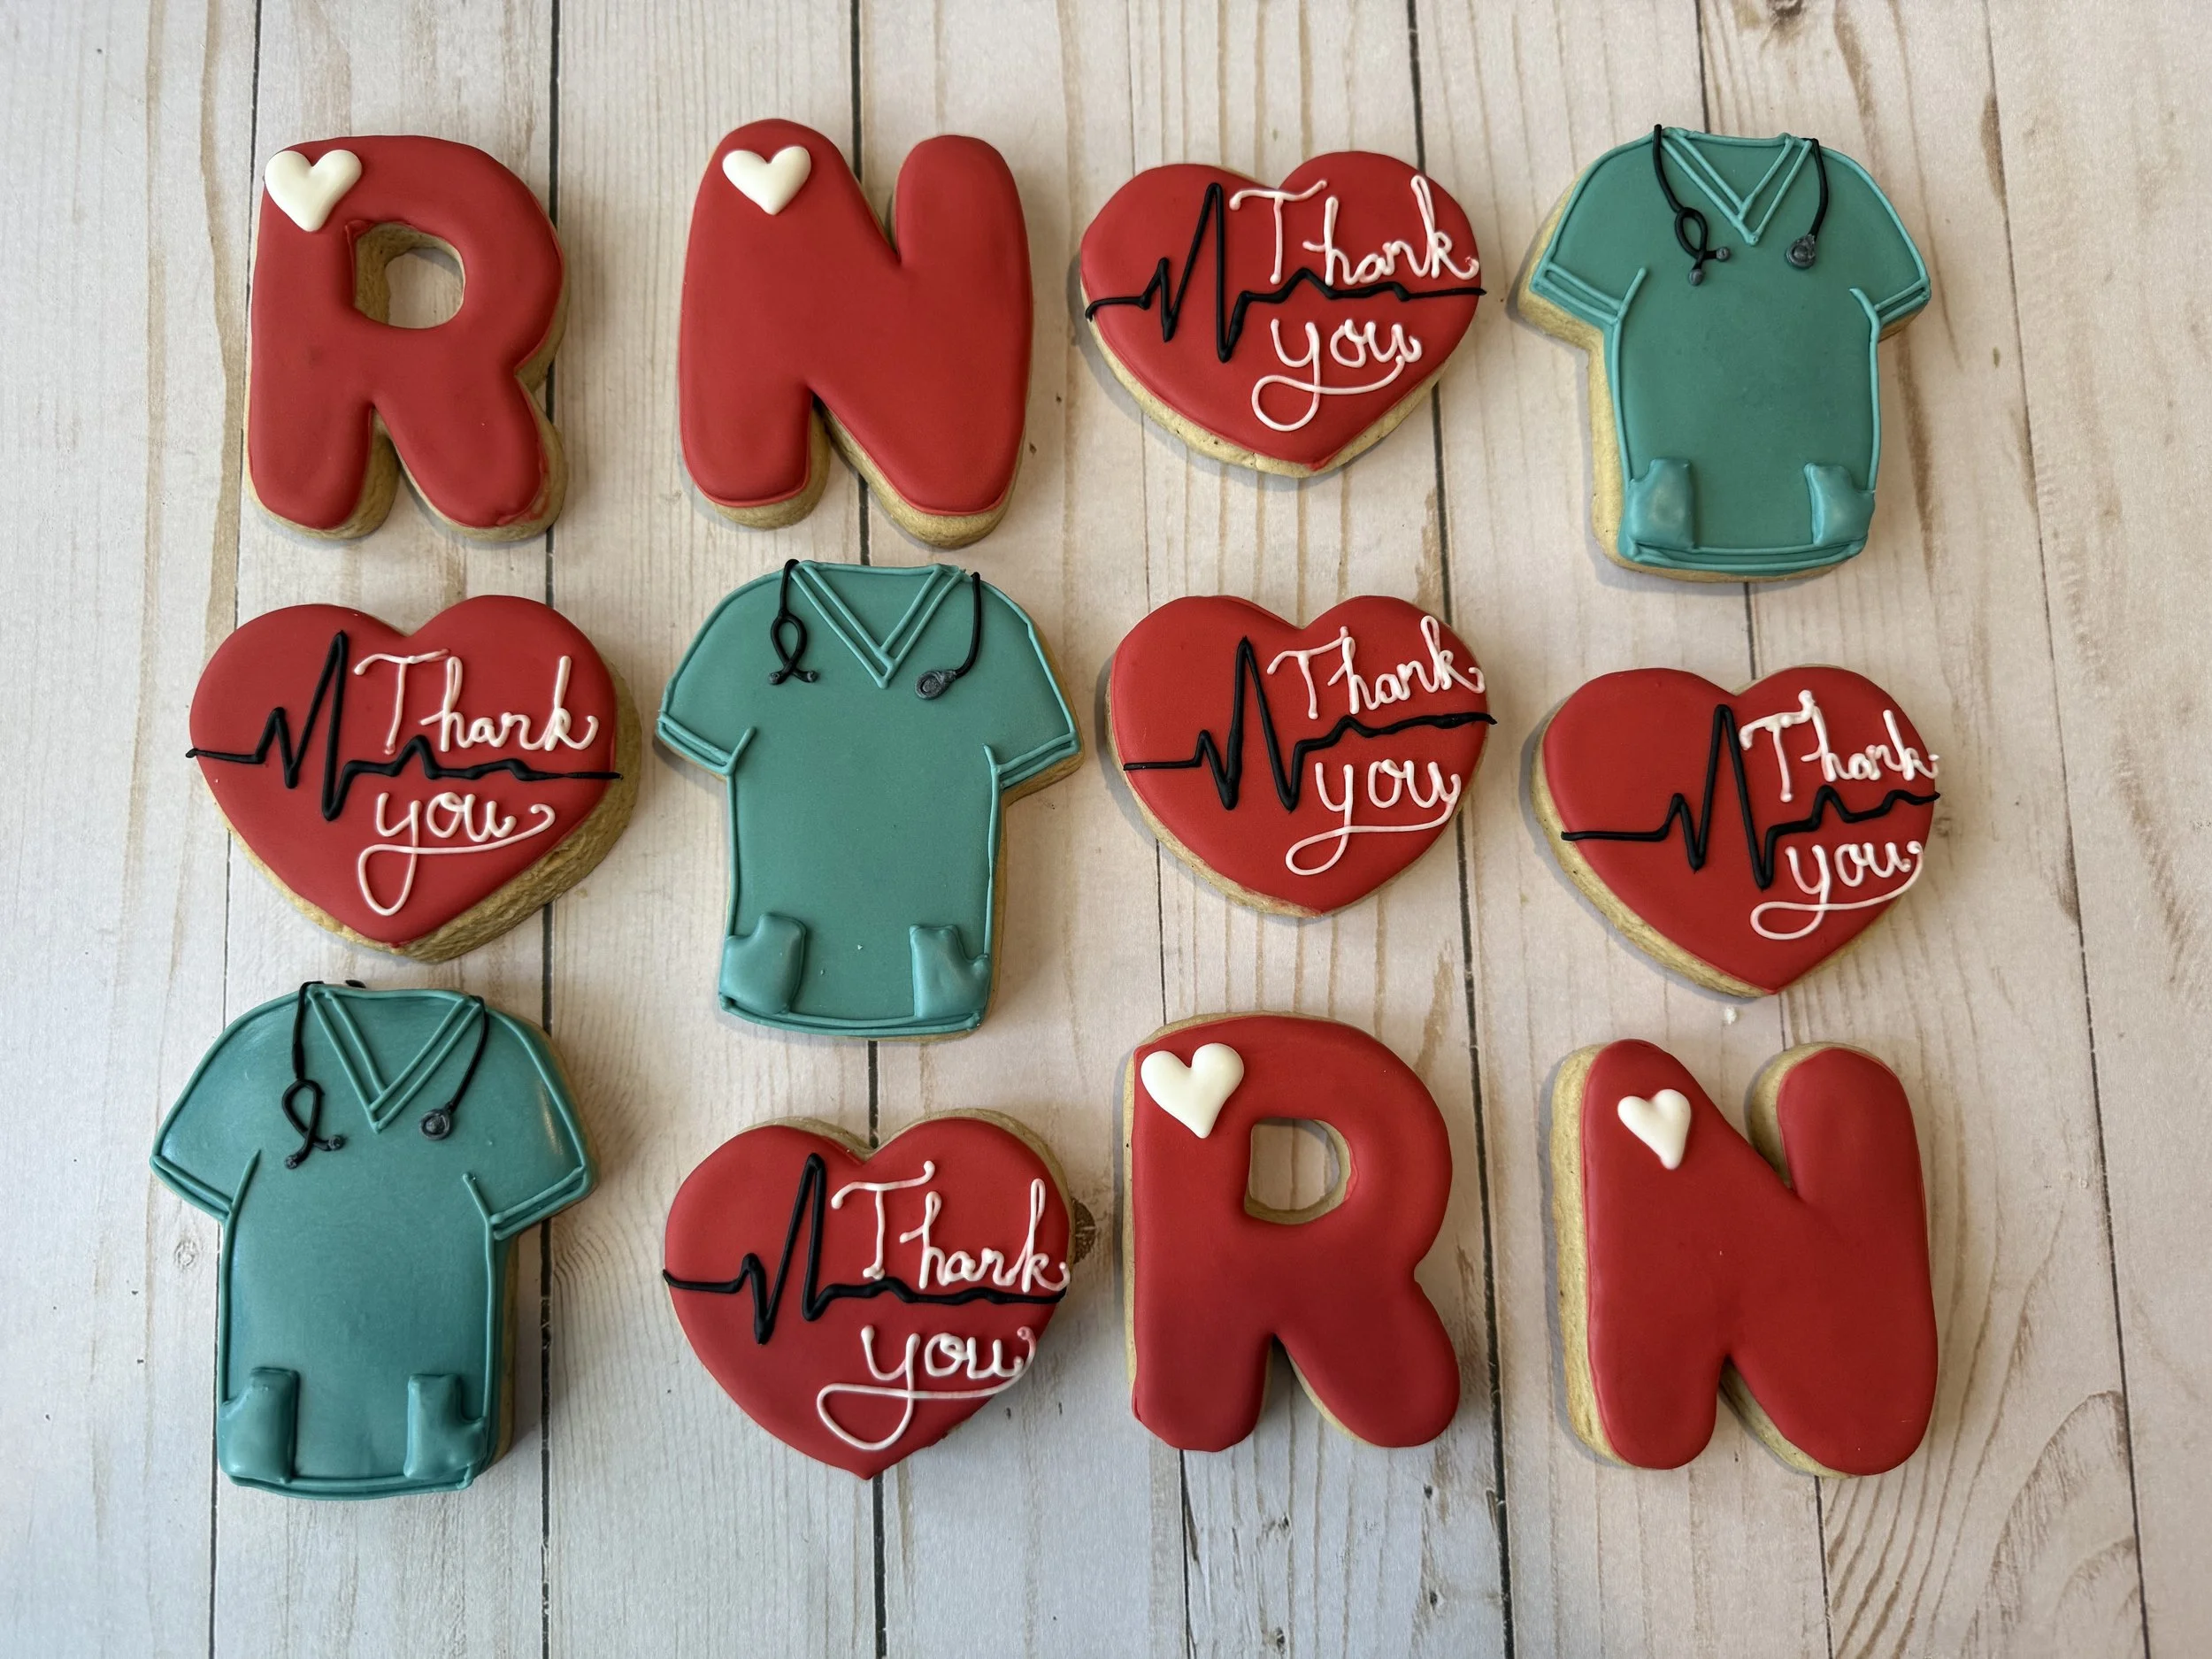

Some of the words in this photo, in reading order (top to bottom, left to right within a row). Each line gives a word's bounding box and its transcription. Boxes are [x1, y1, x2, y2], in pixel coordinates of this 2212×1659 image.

[1230, 174, 1481, 285] Thank
[249, 134, 565, 533] R
[680, 119, 1033, 517] N
[1252, 319, 1422, 431] you
[353, 649, 598, 754] Thank
[1267, 616, 1486, 719] Thank
[1740, 690, 1939, 802] Thank
[357, 792, 555, 916] you
[1286, 759, 1461, 875] you
[1751, 841, 1924, 940] you
[831, 1161, 1070, 1293] Thank
[1133, 1017, 1462, 1452] R
[1583, 1041, 1938, 1476] N
[817, 1326, 1035, 1450] you
